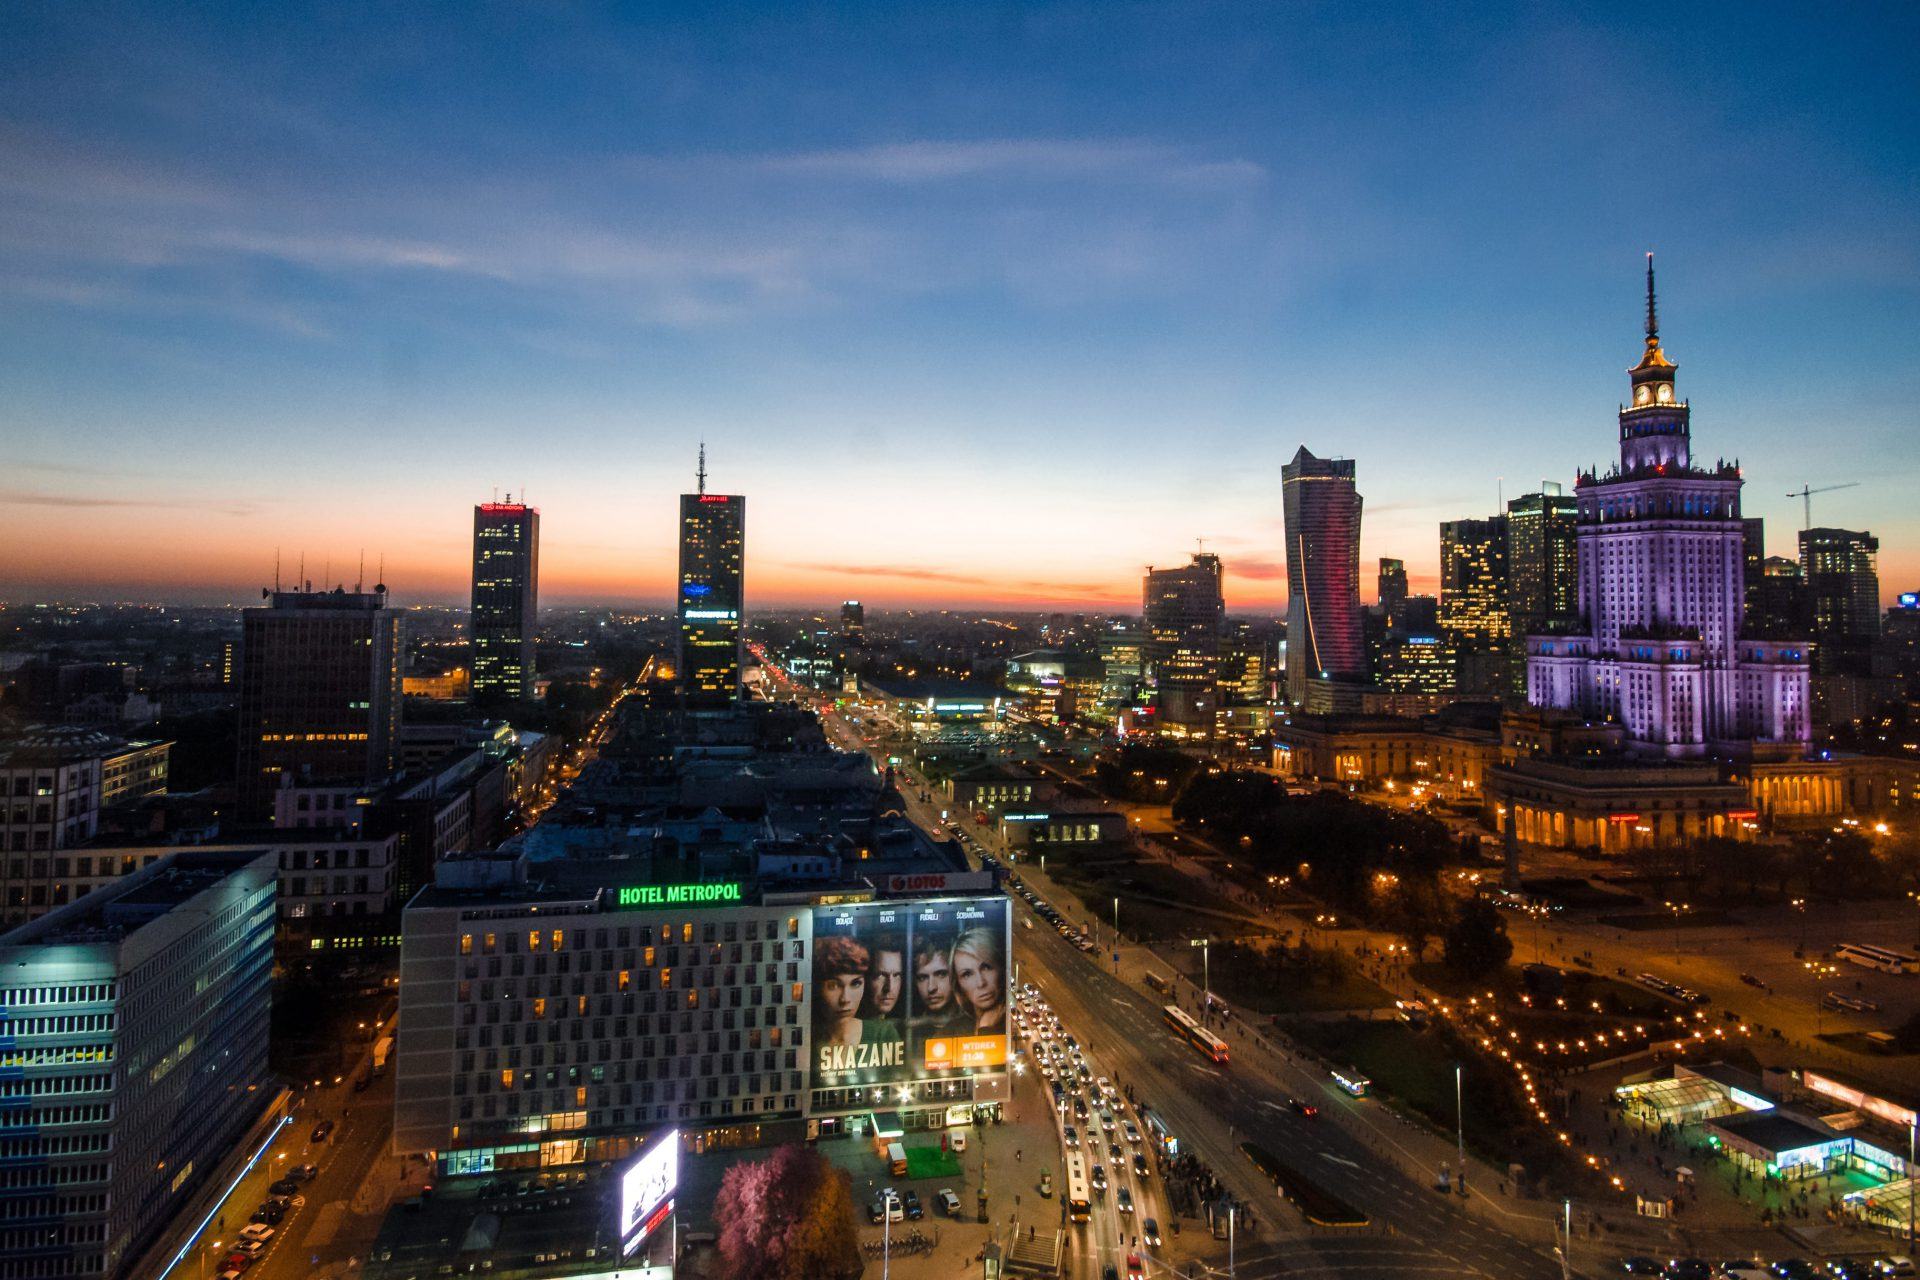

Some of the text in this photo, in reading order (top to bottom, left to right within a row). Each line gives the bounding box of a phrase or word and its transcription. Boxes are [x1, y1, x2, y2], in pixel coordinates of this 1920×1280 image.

[907, 876, 945, 889] LOTOS
[620, 884, 740, 904] HOTEL METROPOL
[820, 1041, 904, 1071] SKAZANE
